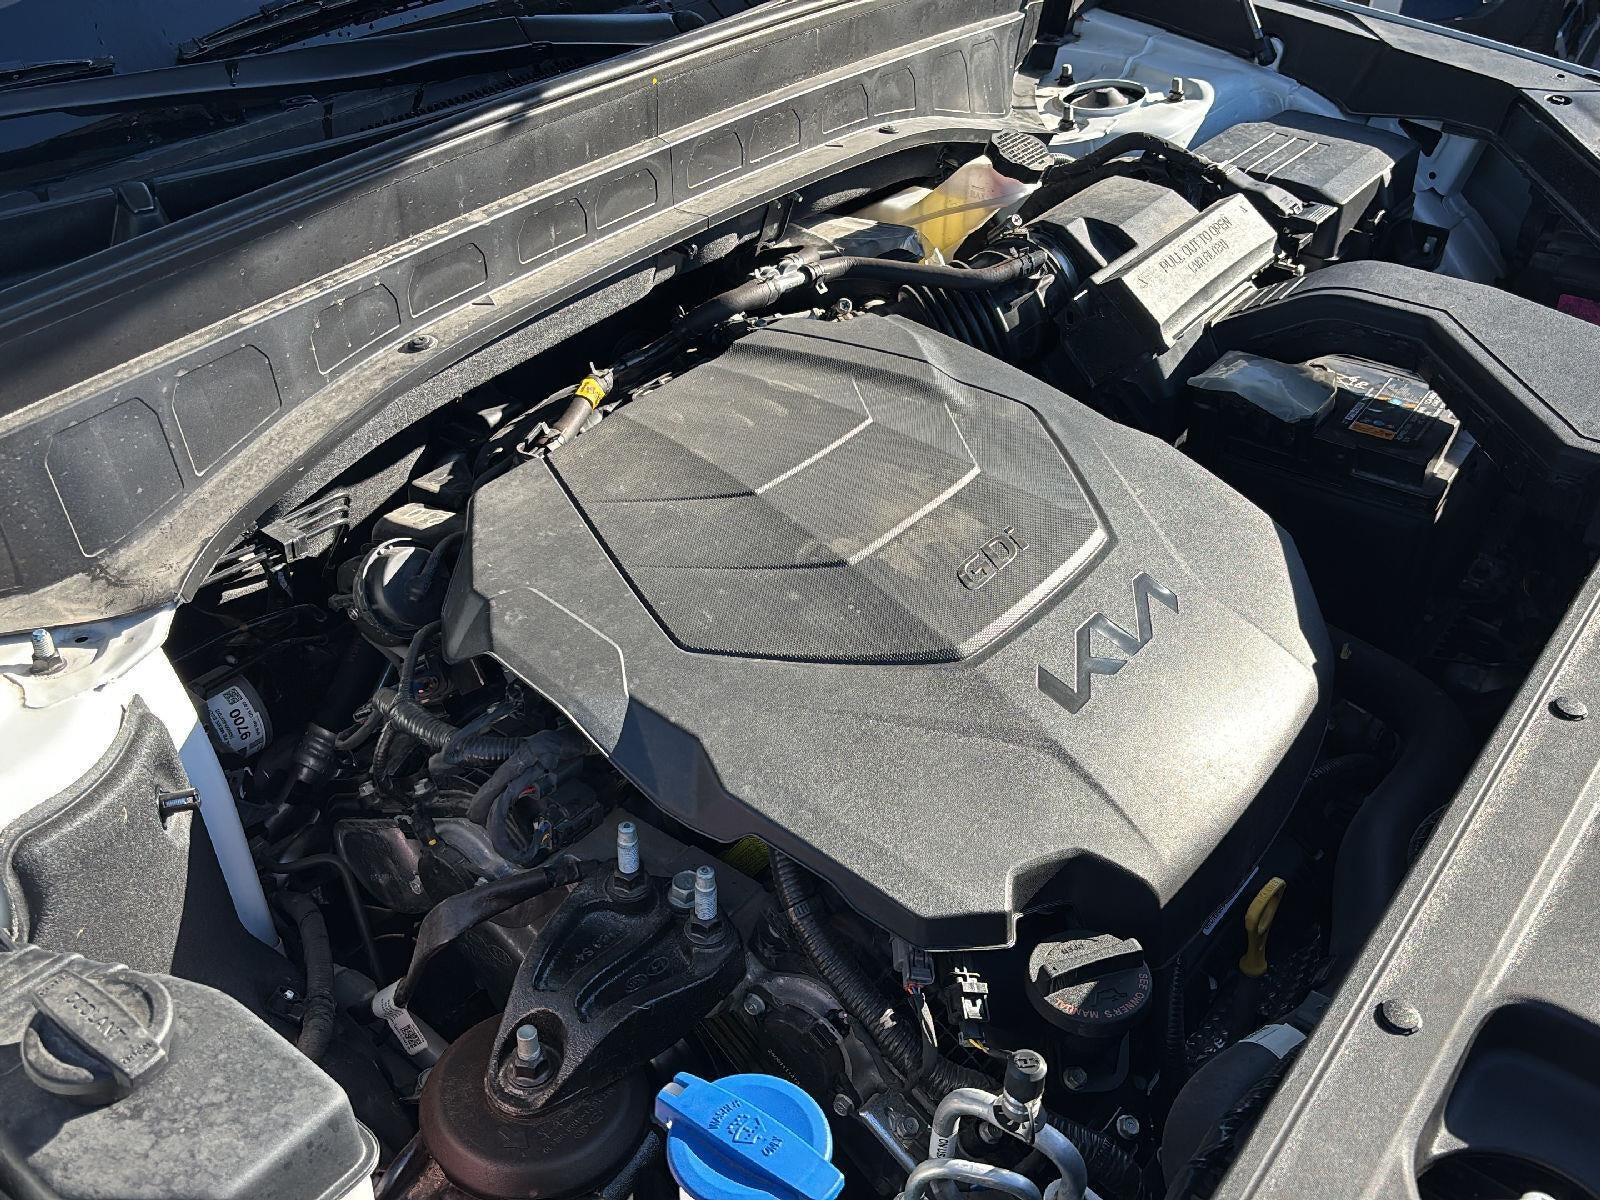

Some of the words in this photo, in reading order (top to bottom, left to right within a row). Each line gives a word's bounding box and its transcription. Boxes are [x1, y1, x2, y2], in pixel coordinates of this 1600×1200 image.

[1159, 252, 1185, 273] PULL
[1181, 235, 1202, 257] OUT
[1199, 230, 1213, 246] TO
[1208, 216, 1232, 238] OPEN
[1036, 571, 1179, 715] KIA
[229, 708, 251, 741] 9700
[1138, 973, 1149, 991] SEE
[64, 990, 130, 1043] COOLANT
[1055, 997, 1099, 1019] MANUAL
[1103, 992, 1146, 1018] OWNER'S
